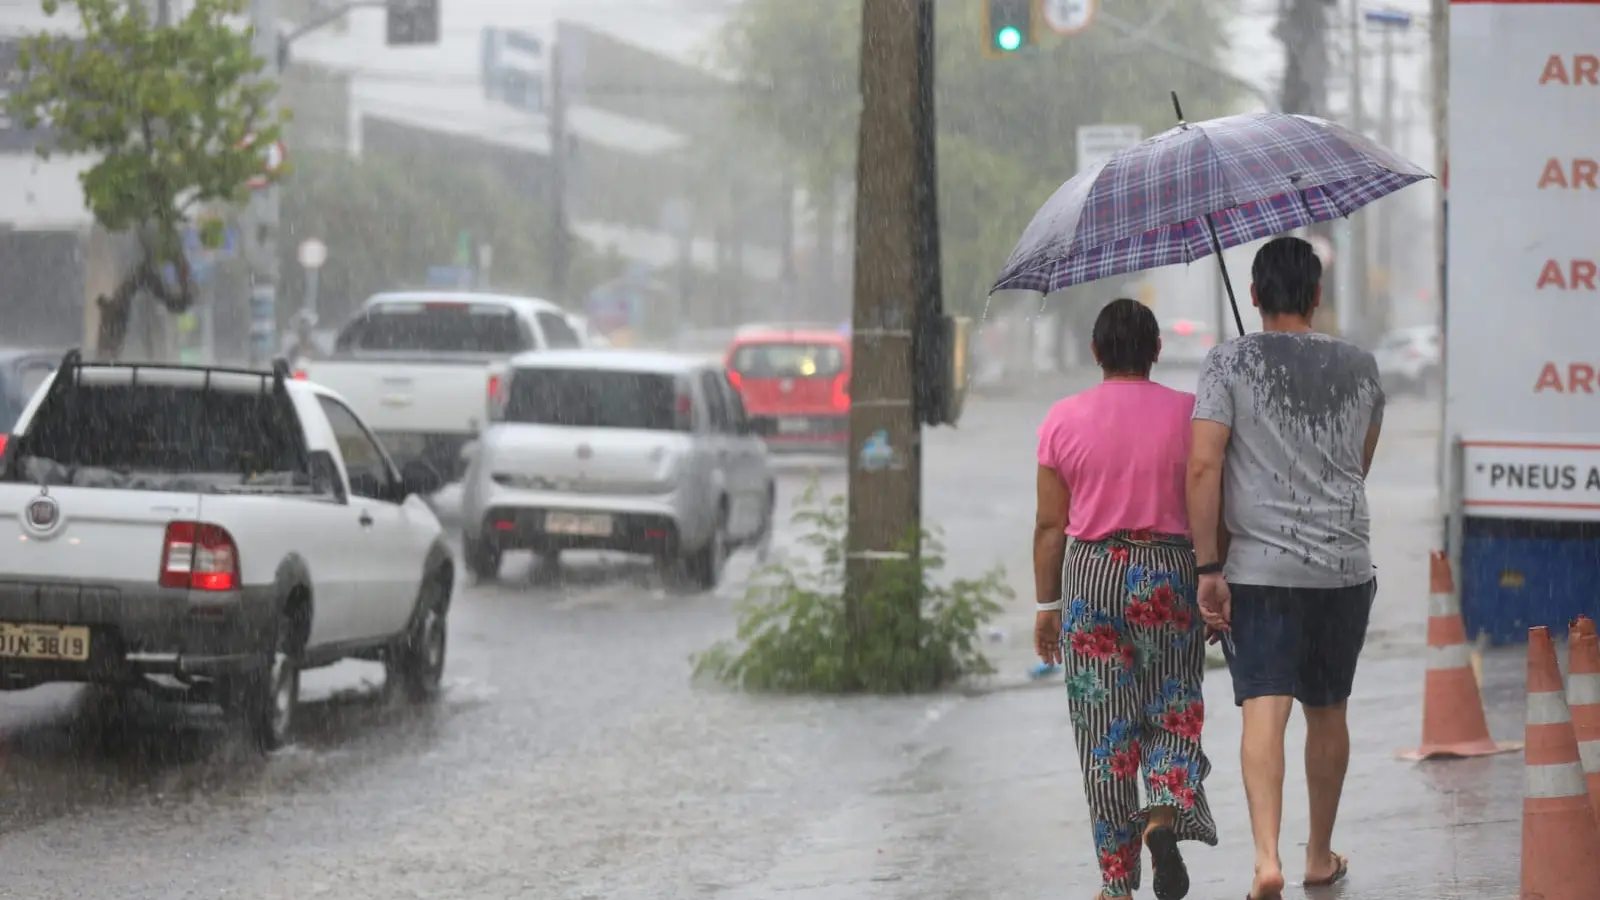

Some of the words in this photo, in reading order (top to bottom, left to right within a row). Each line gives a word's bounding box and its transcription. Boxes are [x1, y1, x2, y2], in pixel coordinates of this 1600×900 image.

[1538, 54, 1600, 86] AR
[1537, 156, 1600, 190] AR
[1533, 361, 1600, 393] AR
